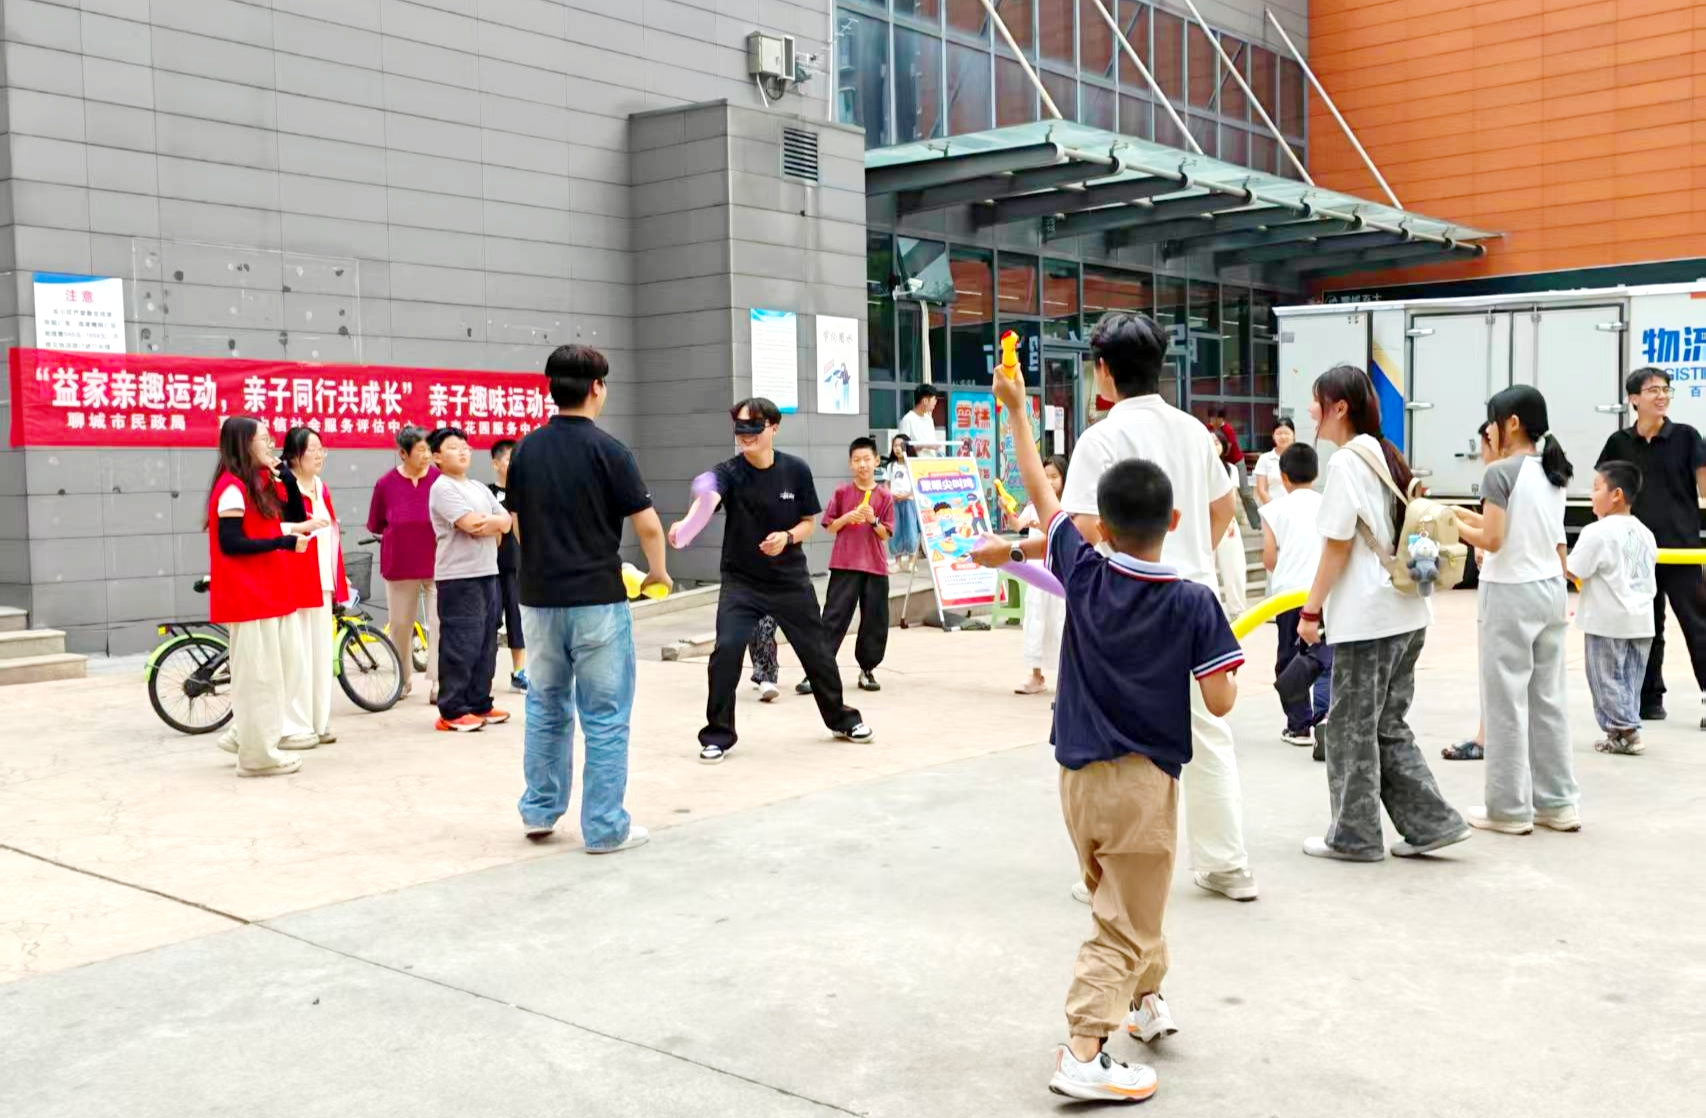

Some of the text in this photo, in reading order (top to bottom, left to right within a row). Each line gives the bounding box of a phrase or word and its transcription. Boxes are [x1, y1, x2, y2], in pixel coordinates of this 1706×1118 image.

[65, 289, 94, 303] 注意
[67, 411, 186, 431] 聊城市民政局
